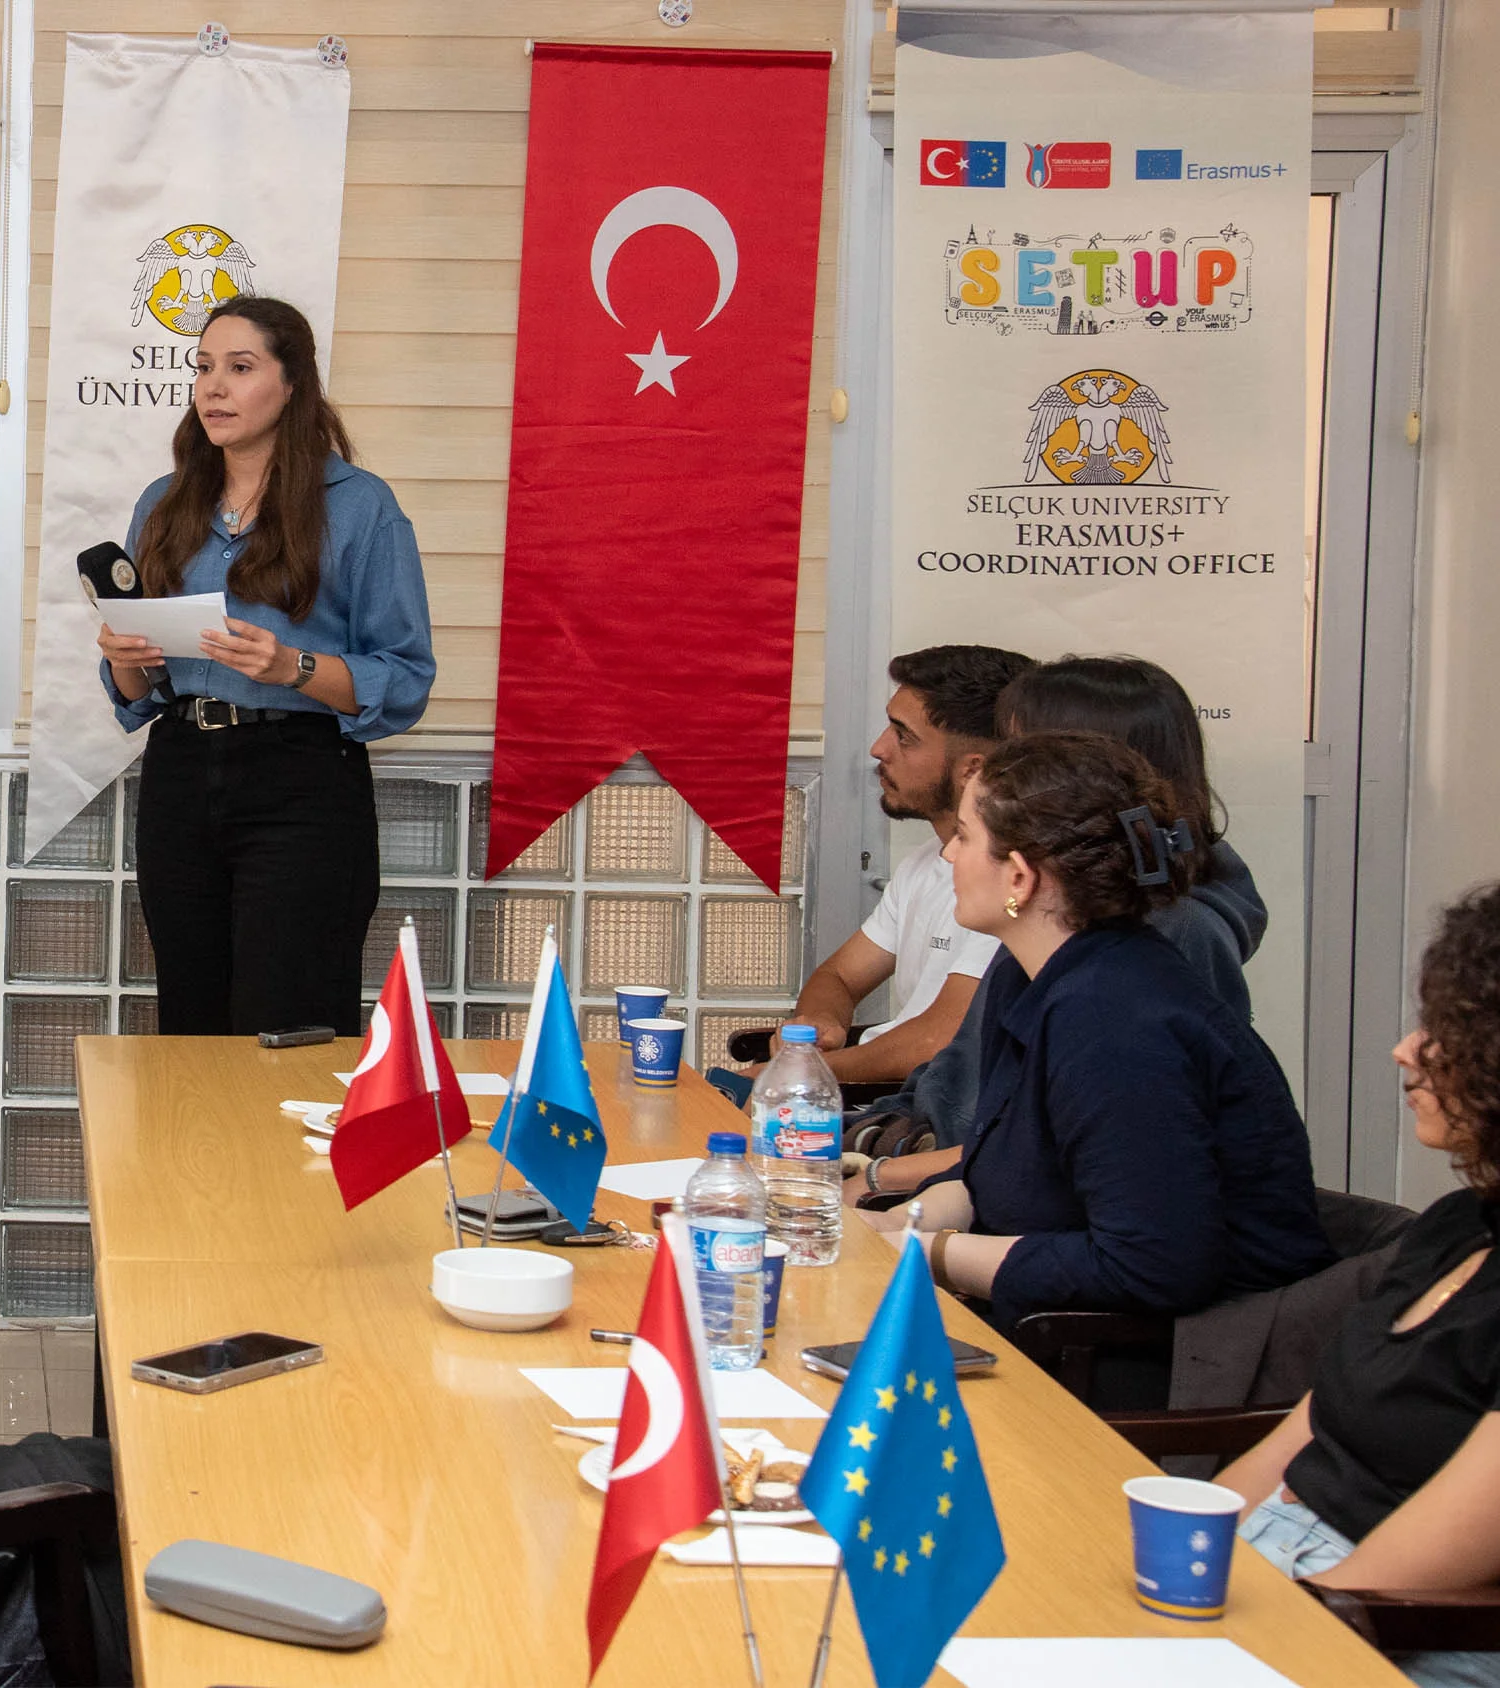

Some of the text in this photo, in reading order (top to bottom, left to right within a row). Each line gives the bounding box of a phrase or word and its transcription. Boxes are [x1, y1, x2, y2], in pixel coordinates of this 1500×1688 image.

[1187, 162, 1288, 180] Erasmus+
[960, 249, 1237, 308] SETUP
[1186, 307, 1206, 316] your
[1189, 314, 1236, 322] ERASMUS+
[131, 344, 198, 376] SELÇ
[77, 376, 196, 407] ÜNİVE
[967, 494, 1230, 519] SELÇUK UNIVERSITY
[1015, 522, 1186, 549] ERASMUS+
[917, 551, 1276, 576] COORDINATION OFFICE
[1195, 704, 1231, 720] hus
